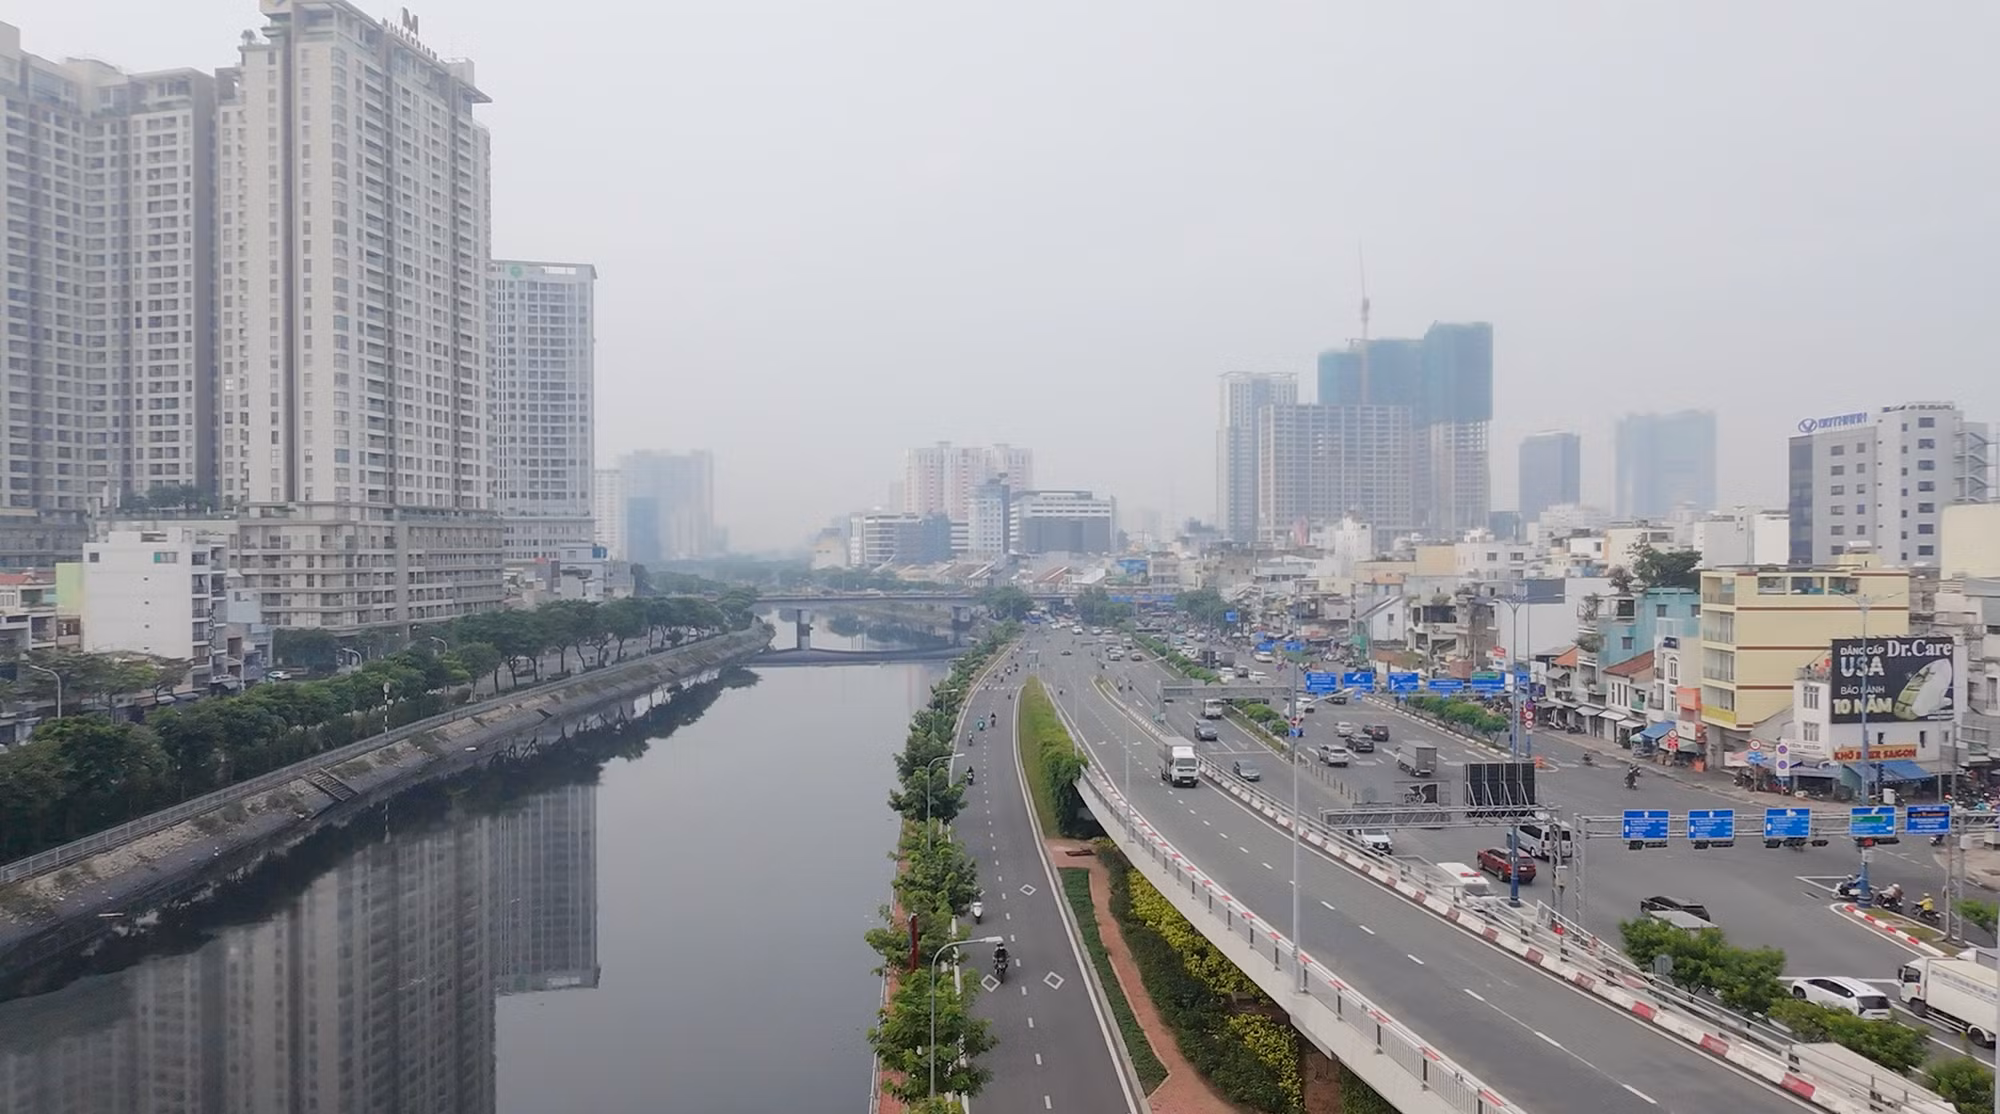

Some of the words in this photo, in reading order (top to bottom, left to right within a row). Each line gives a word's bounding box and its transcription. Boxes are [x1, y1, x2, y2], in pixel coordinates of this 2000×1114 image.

[1886, 639, 1952, 657] Dr.Care
[1840, 656, 1885, 677] USA
[1833, 699, 1851, 715] 10
